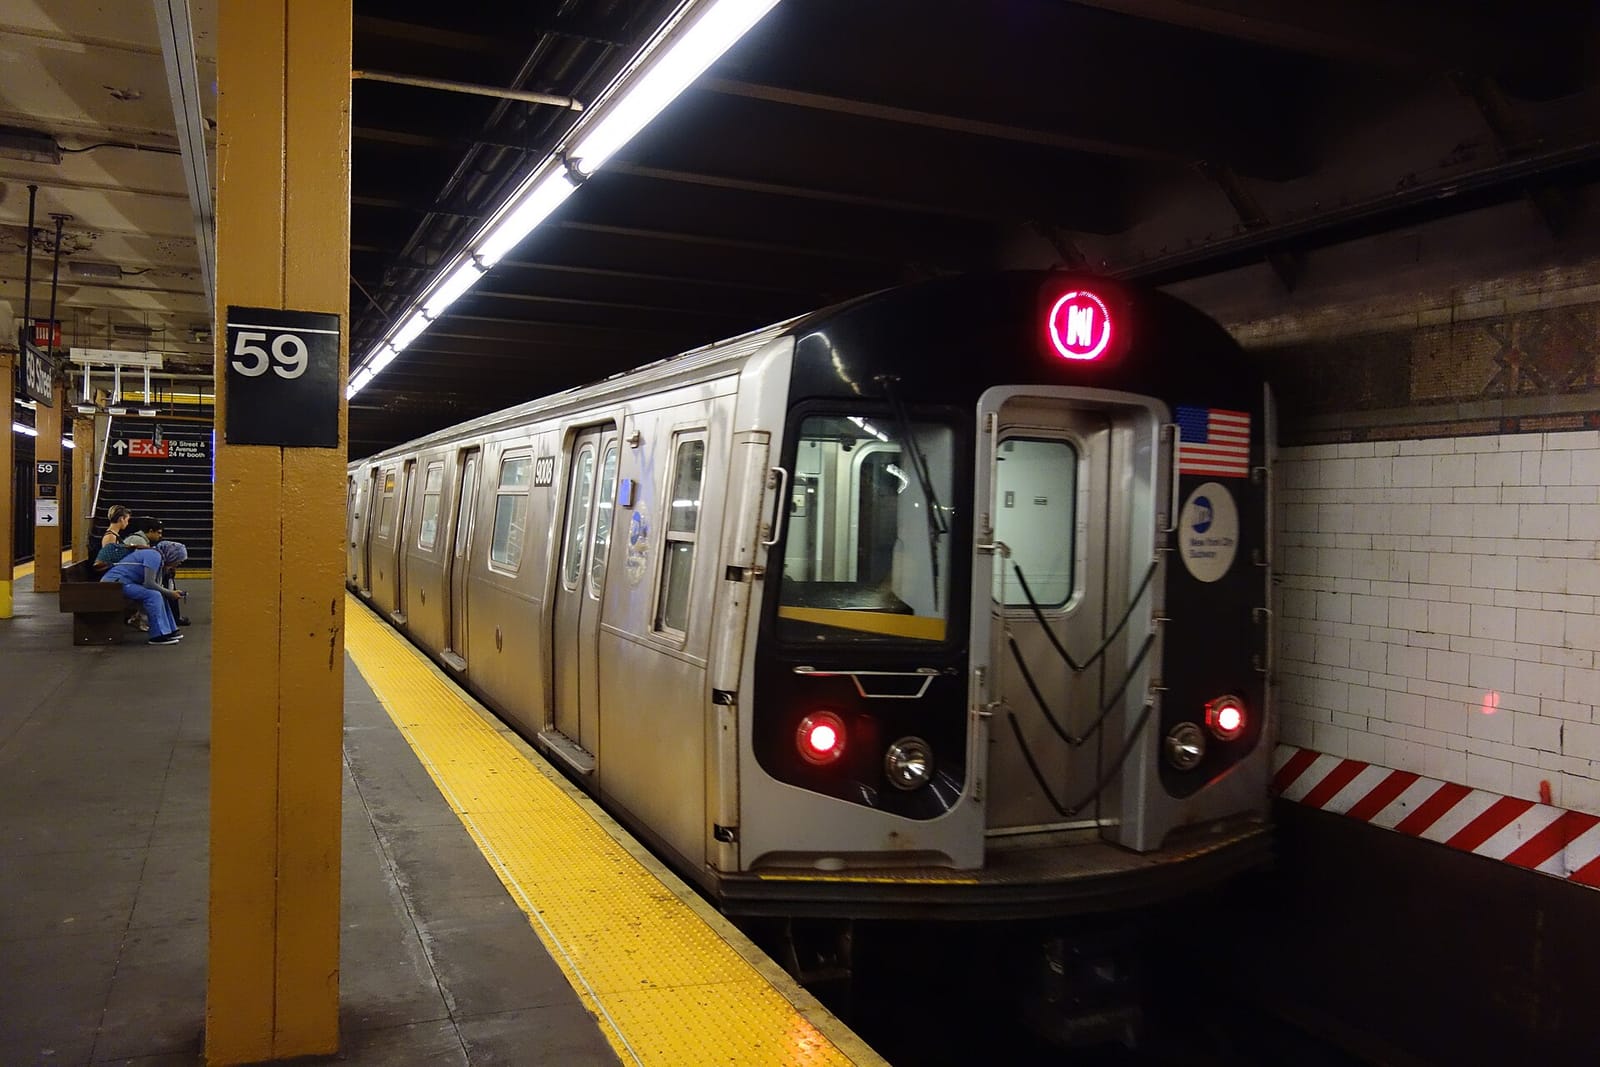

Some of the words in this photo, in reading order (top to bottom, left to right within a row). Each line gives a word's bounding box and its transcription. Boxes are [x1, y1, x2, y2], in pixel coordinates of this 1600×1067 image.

[1066, 304, 1094, 347] N
[26, 348, 36, 389] 59
[231, 331, 309, 379] 59
[38, 464, 53, 473] 59
